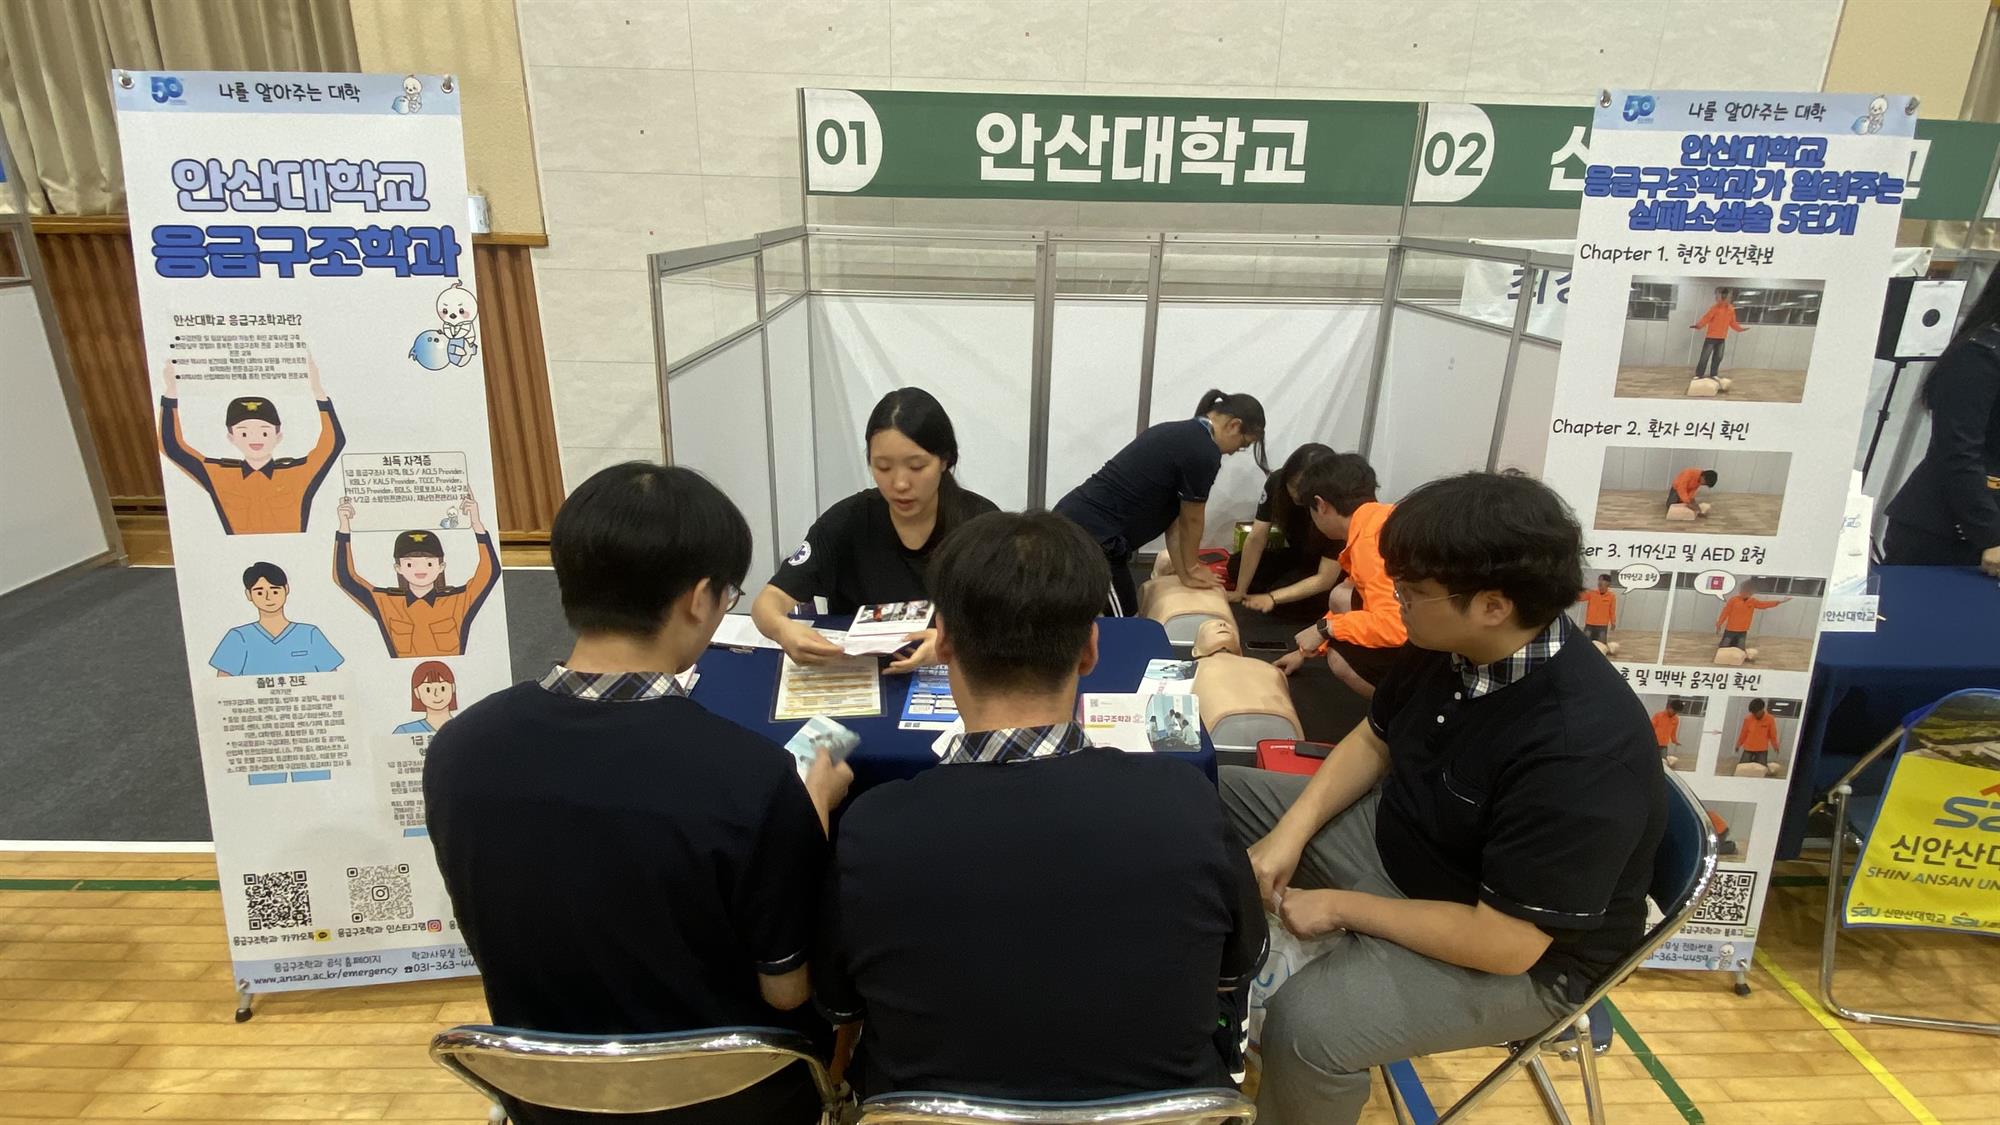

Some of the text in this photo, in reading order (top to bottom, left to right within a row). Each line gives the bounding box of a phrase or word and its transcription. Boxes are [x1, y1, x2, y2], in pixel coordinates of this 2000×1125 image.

[151, 77, 183, 103] 50
[219, 82, 360, 103] 나를 알아주는 대학
[1622, 95, 1655, 122] 50
[1688, 102, 1826, 122] 나를 알아주는 대학
[815, 118, 867, 166] 01
[975, 111, 1309, 186] 안산대학교
[1680, 134, 1828, 168] 안산대학교
[1424, 131, 1487, 177] 02
[171, 158, 431, 213] 안산대학교
[1584, 165, 1905, 205] 응급구조학과가 알려주는
[1629, 199, 1859, 235] 심폐소생술 5단계
[151, 224, 462, 279] 응급구조학과
[1580, 243, 1775, 266] Chapter 1. 현장 안전확보
[173, 314, 302, 326] 안산대학교 응급구조학과란?
[1552, 418, 1750, 440] Chapter 2. 환자 의식 확인
[404, 454, 432, 466] 자격증
[1607, 543, 1621, 557] 3.
[1628, 543, 1677, 560] 119신고
[1682, 544, 1696, 562] 및
[1700, 548, 1735, 562] AED
[1739, 547, 1766, 565] 요청
[257, 675, 307, 688] 졸업 후 진로
[1636, 669, 1650, 687] 및
[1655, 670, 1685, 688] 맥박
[1690, 672, 1728, 690] 움직임
[1733, 673, 1761, 691] 확인
[411, 735, 424, 746] 1급
[1866, 866, 1910, 881] SHIN
[1912, 872, 1974, 888] ANSAN
[233, 931, 315, 946] 응급구조학과 카카오톡
[337, 921, 427, 938] 응급구조학과 인스타그램
[274, 955, 382, 973] 응급구조학과 공식 홈페이지
[412, 948, 456, 960] 학과사무실
[1646, 952, 1709, 963] 1-363-4459
[254, 966, 398, 985] www.ansan.ac.kr/emergency
[413, 959, 477, 974] 031-363-44
